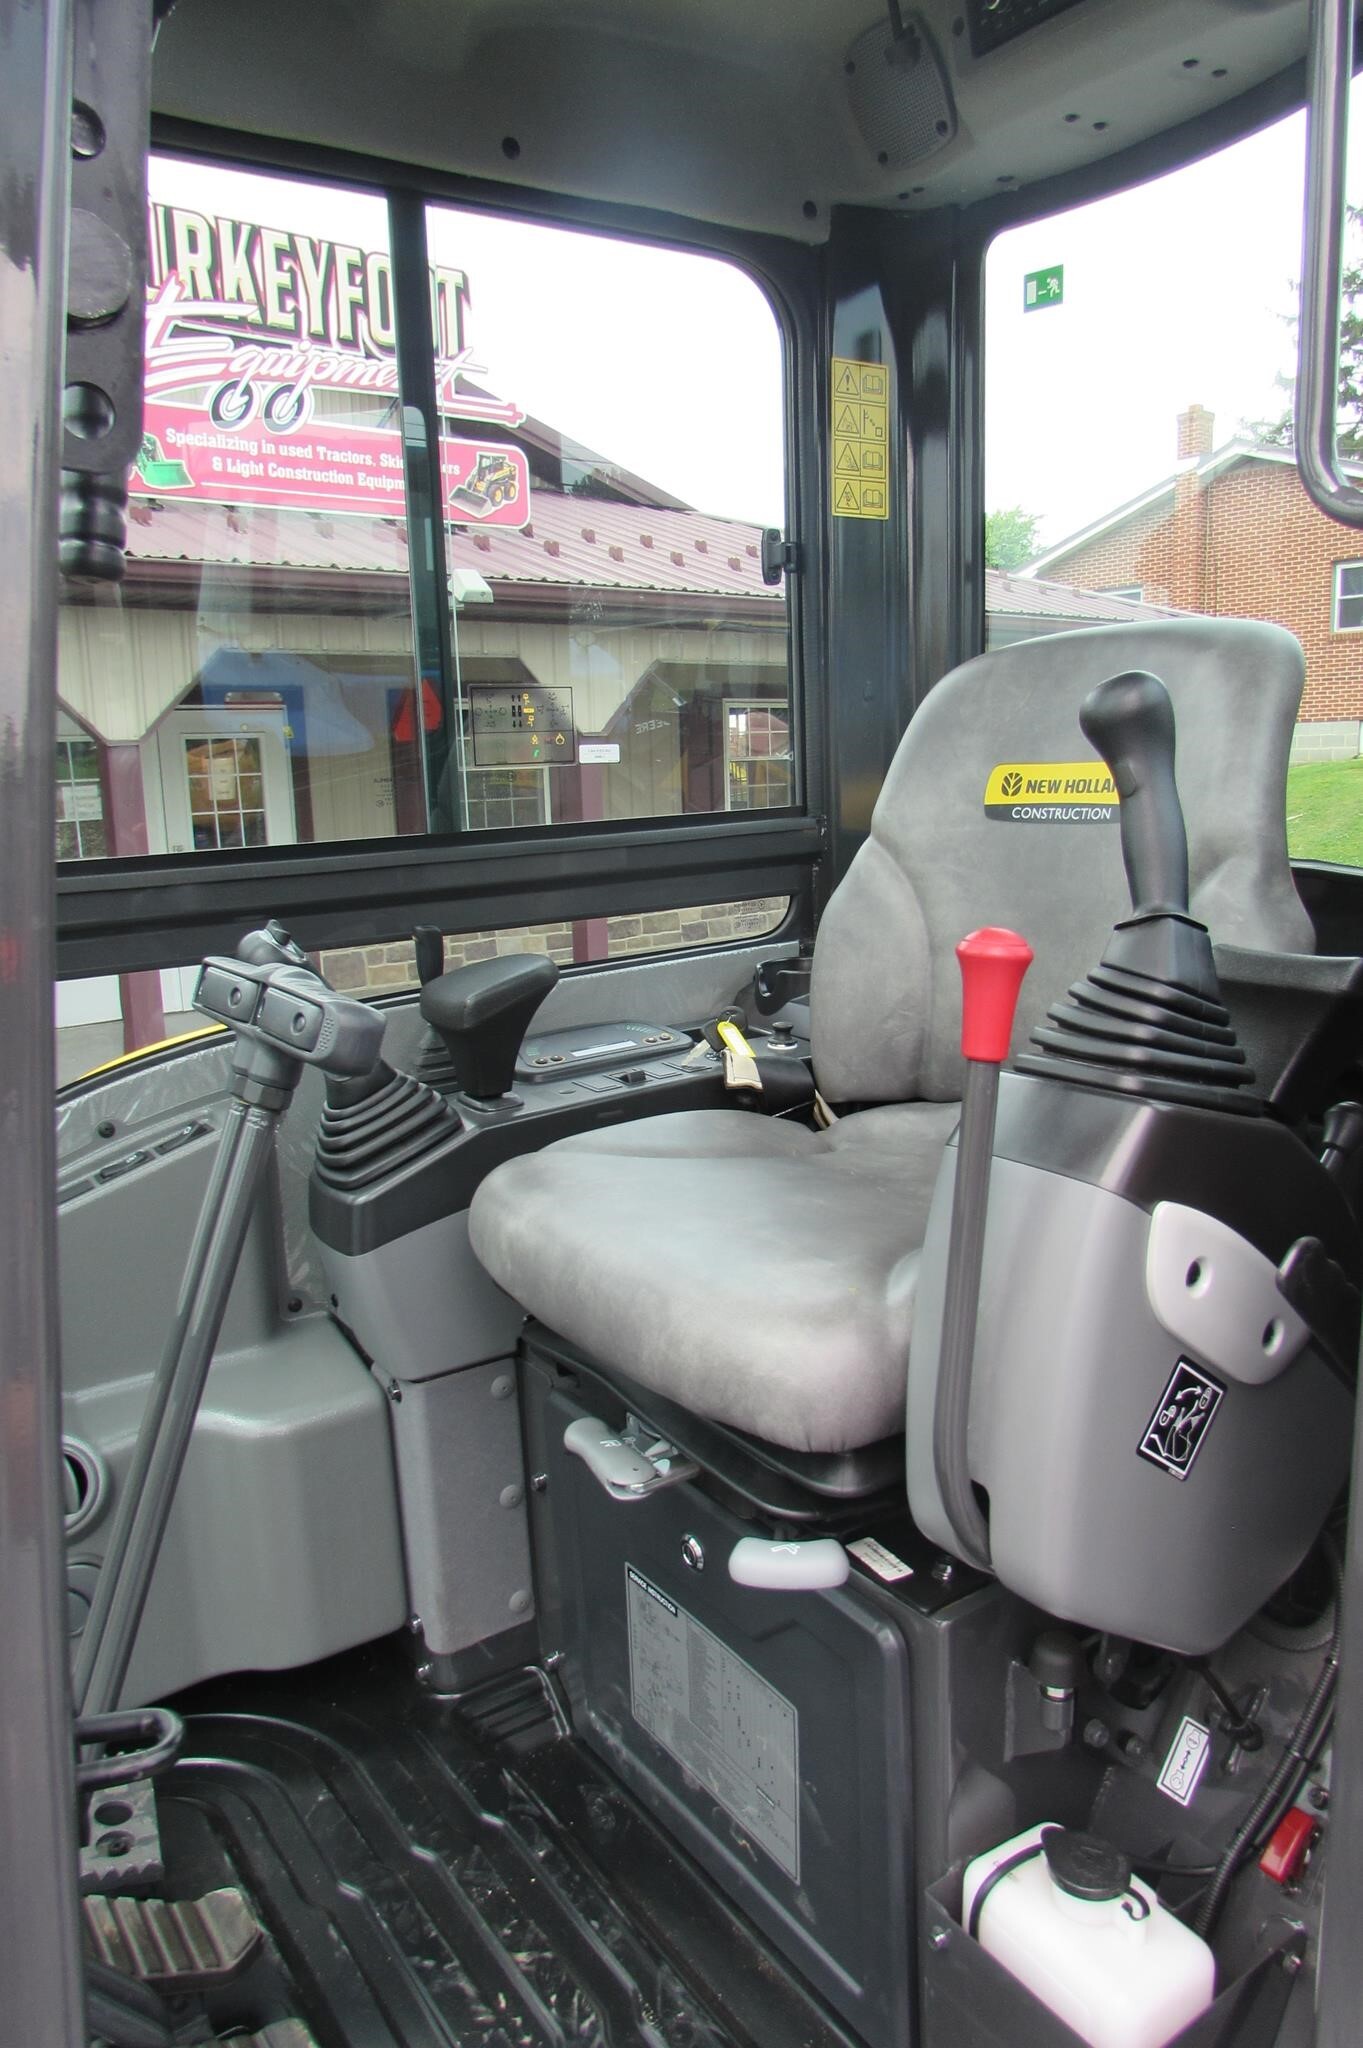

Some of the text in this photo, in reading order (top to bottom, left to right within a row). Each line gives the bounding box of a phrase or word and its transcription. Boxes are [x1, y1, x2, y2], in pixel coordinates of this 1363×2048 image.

[145, 270, 488, 417] Equipmet
[166, 428, 258, 455] Specializing
[261, 438, 276, 455] in
[278, 441, 313, 460] used
[212, 456, 405, 492] & Light Construction Equipm
[1025, 778, 1117, 794] NEW HOLLA
[1011, 806, 1111, 820] CONSTRUCTION
